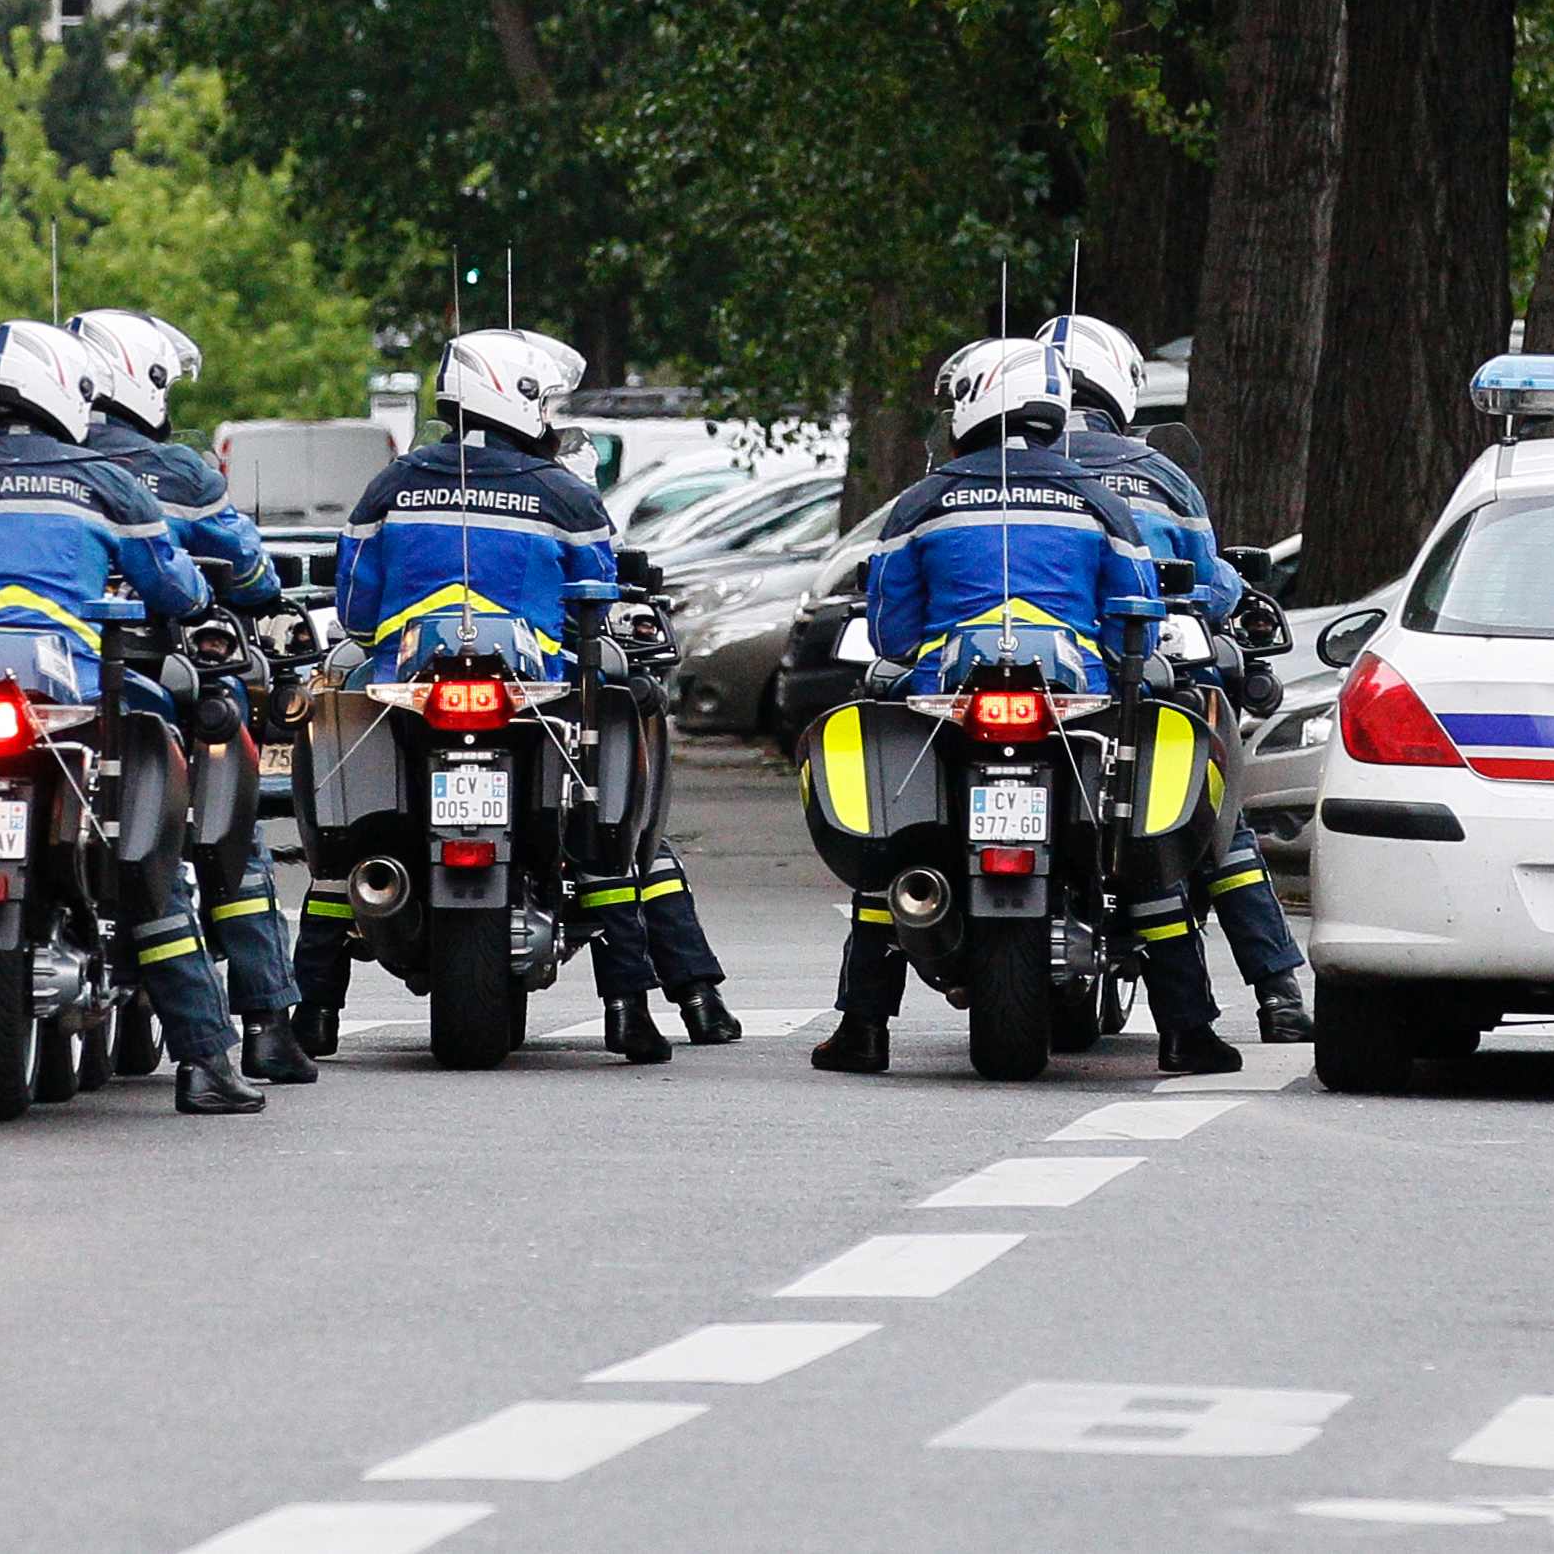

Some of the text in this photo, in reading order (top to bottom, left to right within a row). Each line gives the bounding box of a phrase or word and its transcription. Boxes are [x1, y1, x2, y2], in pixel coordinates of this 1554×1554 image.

[396, 488, 541, 514] GENDARMERIE
[941, 487, 1086, 511] GENDARMERIE
[436, 800, 503, 819] 005-DD
[974, 815, 1042, 834] 977-GD
